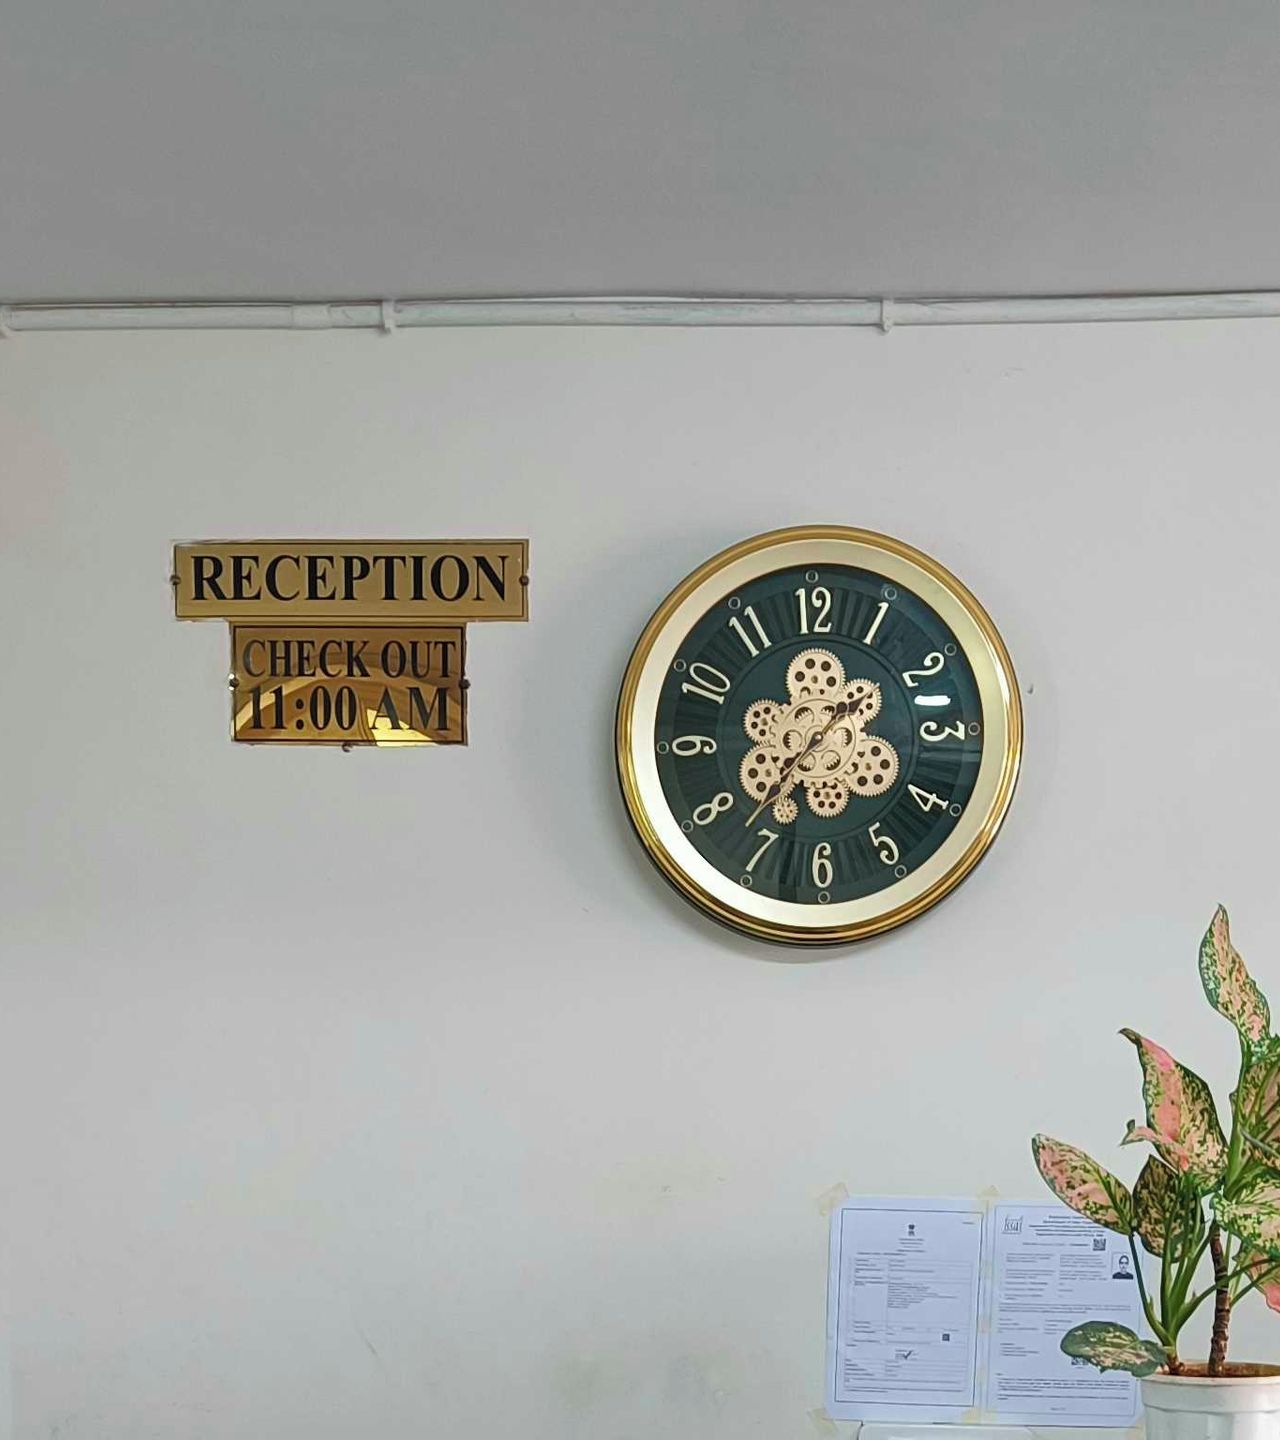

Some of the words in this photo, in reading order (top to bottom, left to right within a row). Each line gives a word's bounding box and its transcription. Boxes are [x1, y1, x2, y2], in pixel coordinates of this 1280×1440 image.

[191, 554, 510, 602] RECEPTION
[728, 605, 772, 657] 11
[795, 586, 833, 634] 12
[863, 602, 889, 646] 1
[242, 639, 371, 679] CHECK
[380, 639, 456, 679] OUT
[902, 651, 945, 688] 2
[681, 662, 731, 705] 10
[248, 685, 357, 731] 11:00
[370, 685, 453, 731] AM
[671, 734, 717, 757] 9
[920, 720, 966, 742] 3
[692, 791, 734, 826] 8
[907, 783, 949, 813] 4
[746, 828, 779, 872] 7
[868, 821, 900, 865] 5
[811, 842, 834, 889] 6
